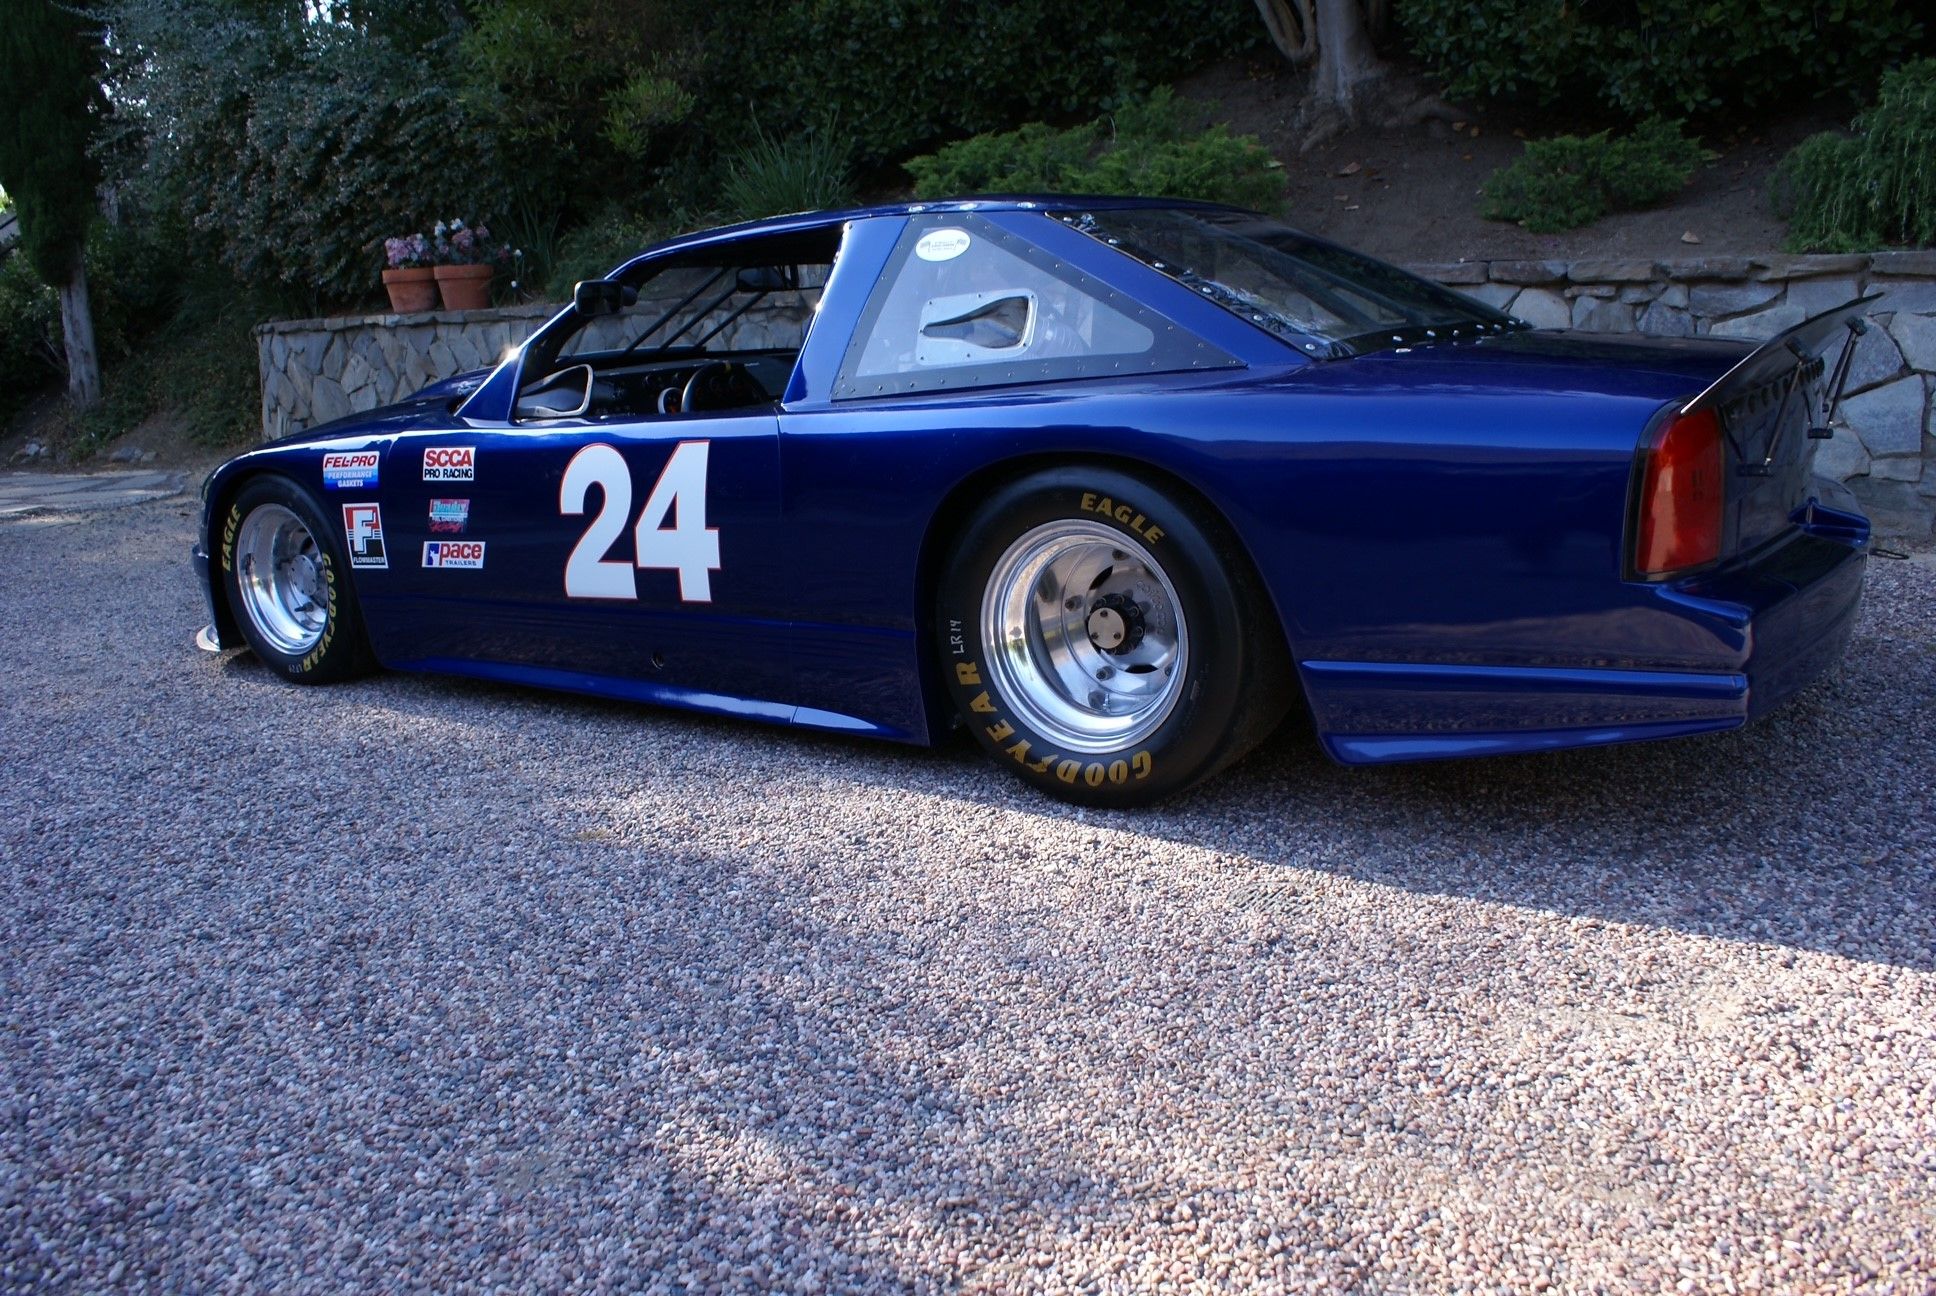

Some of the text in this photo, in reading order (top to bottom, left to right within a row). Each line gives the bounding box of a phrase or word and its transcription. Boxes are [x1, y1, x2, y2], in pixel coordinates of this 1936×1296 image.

[325, 455, 377, 468] FEL-PRO
[425, 449, 472, 467] SCCA
[328, 470, 373, 479] PERFORMANCE
[424, 468, 473, 479] PRO RACING
[337, 480, 364, 488] GASKETS
[560, 439, 721, 603] 24
[1081, 492, 1165, 544] EAGLE
[222, 504, 241, 571] EAGLE
[439, 543, 482, 566] pace
[956, 661, 1152, 787] GOODYEAR
